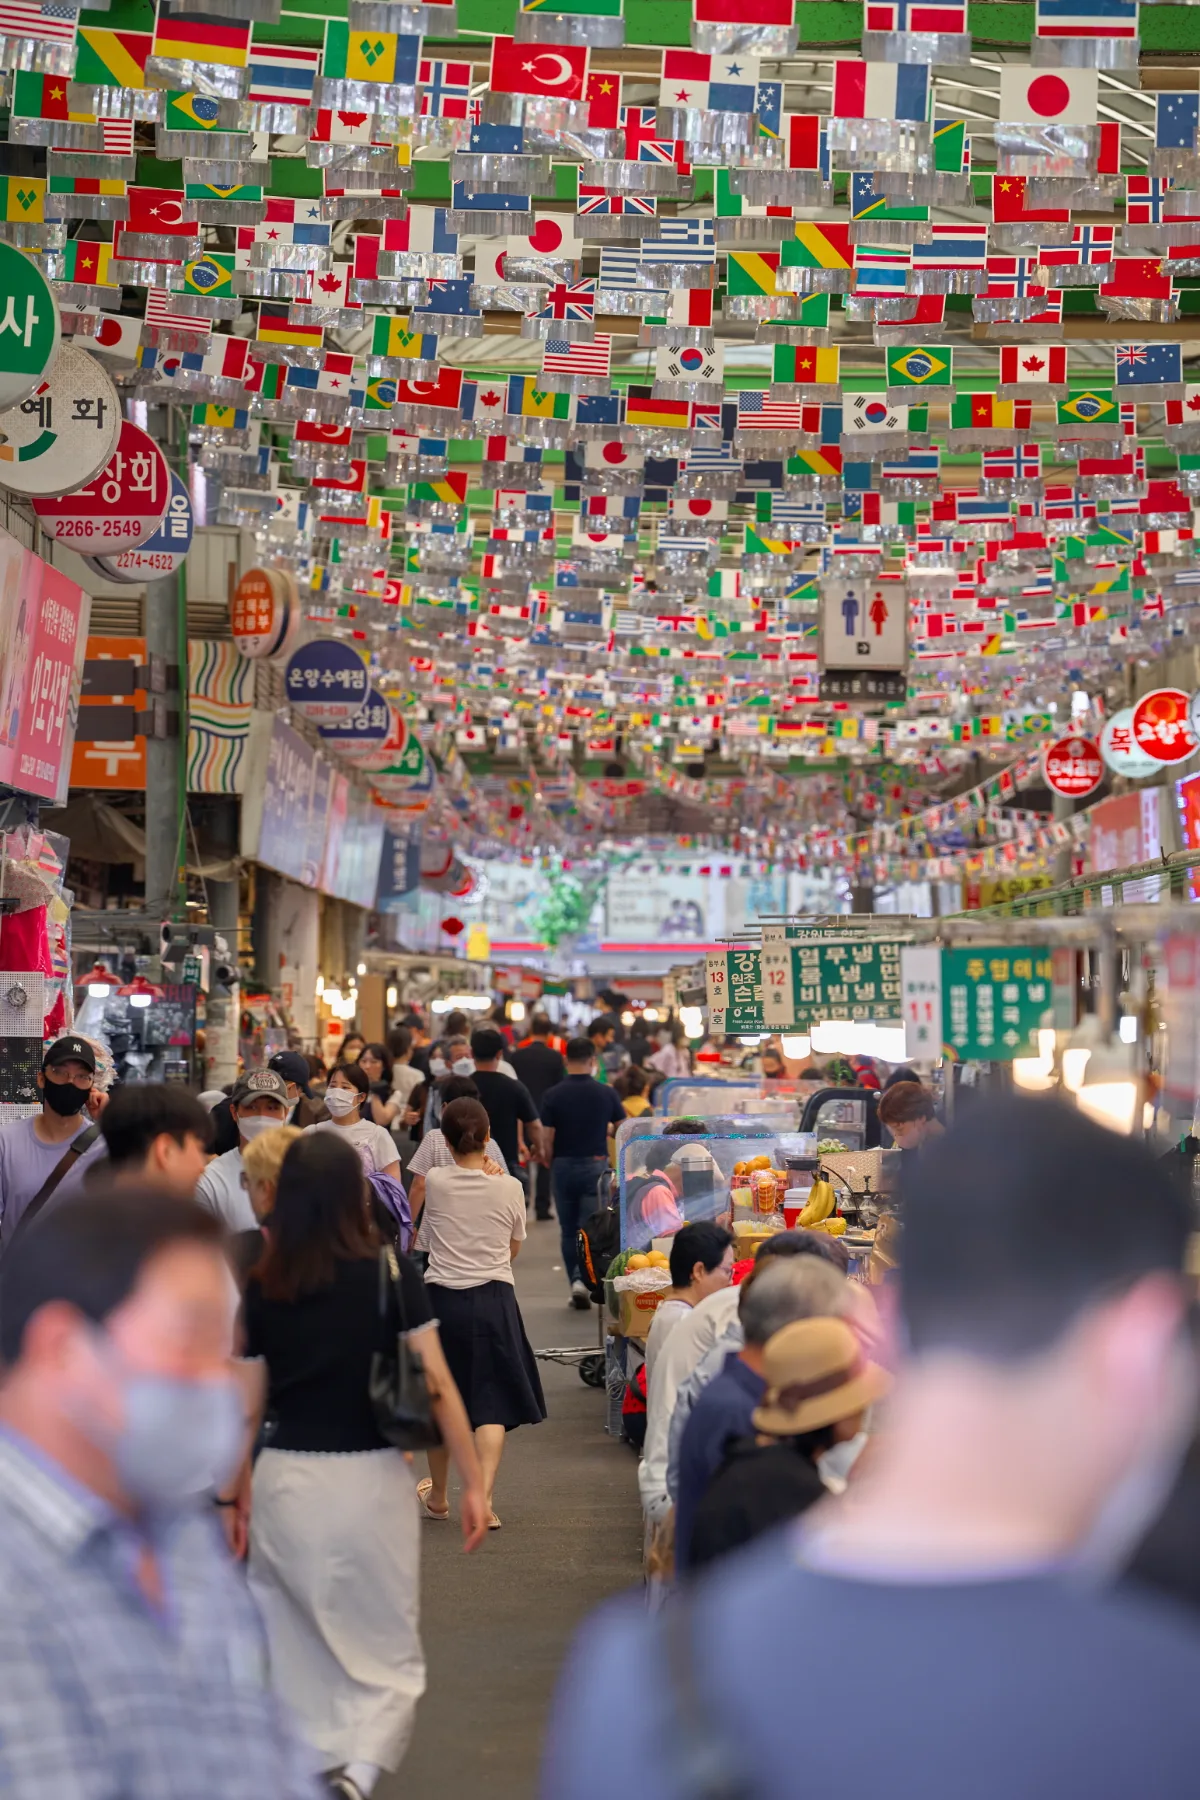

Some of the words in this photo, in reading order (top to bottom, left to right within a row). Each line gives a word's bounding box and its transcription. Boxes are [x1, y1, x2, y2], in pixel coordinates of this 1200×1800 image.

[56, 519, 142, 537] 2266-2549
[117, 552, 173, 571] 2274-4522
[288, 668, 365, 689] 온양수예점
[322, 706, 387, 731] 상회
[710, 971, 724, 983] 13
[731, 973, 756, 985] 원조
[768, 971, 786, 986] 12
[713, 986, 723, 996] 호
[909, 1001, 932, 1022] 11
